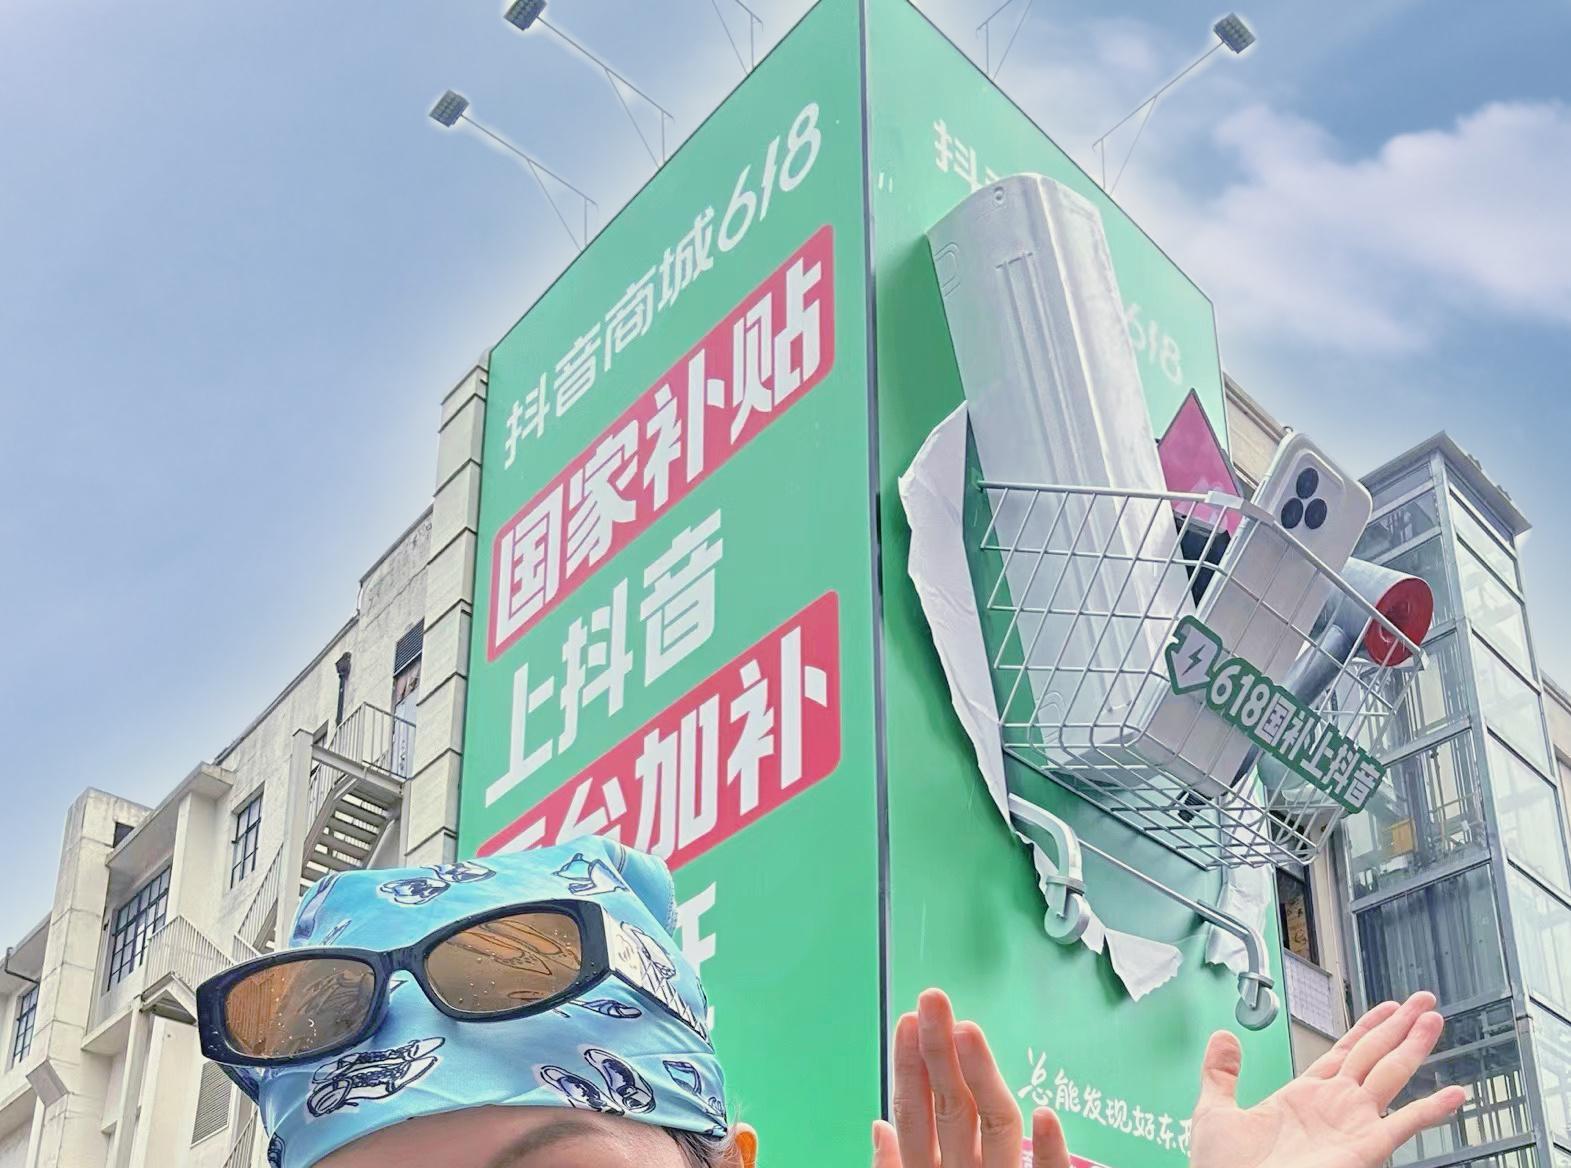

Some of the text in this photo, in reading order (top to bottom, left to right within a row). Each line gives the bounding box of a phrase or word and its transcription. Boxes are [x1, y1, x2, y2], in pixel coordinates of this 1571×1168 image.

[504, 103, 822, 468] 抖音商城618
[495, 258, 822, 646] 国家补贴
[485, 509, 723, 807] 上抖音
[1211, 665, 1382, 808] 618国补上抖音
